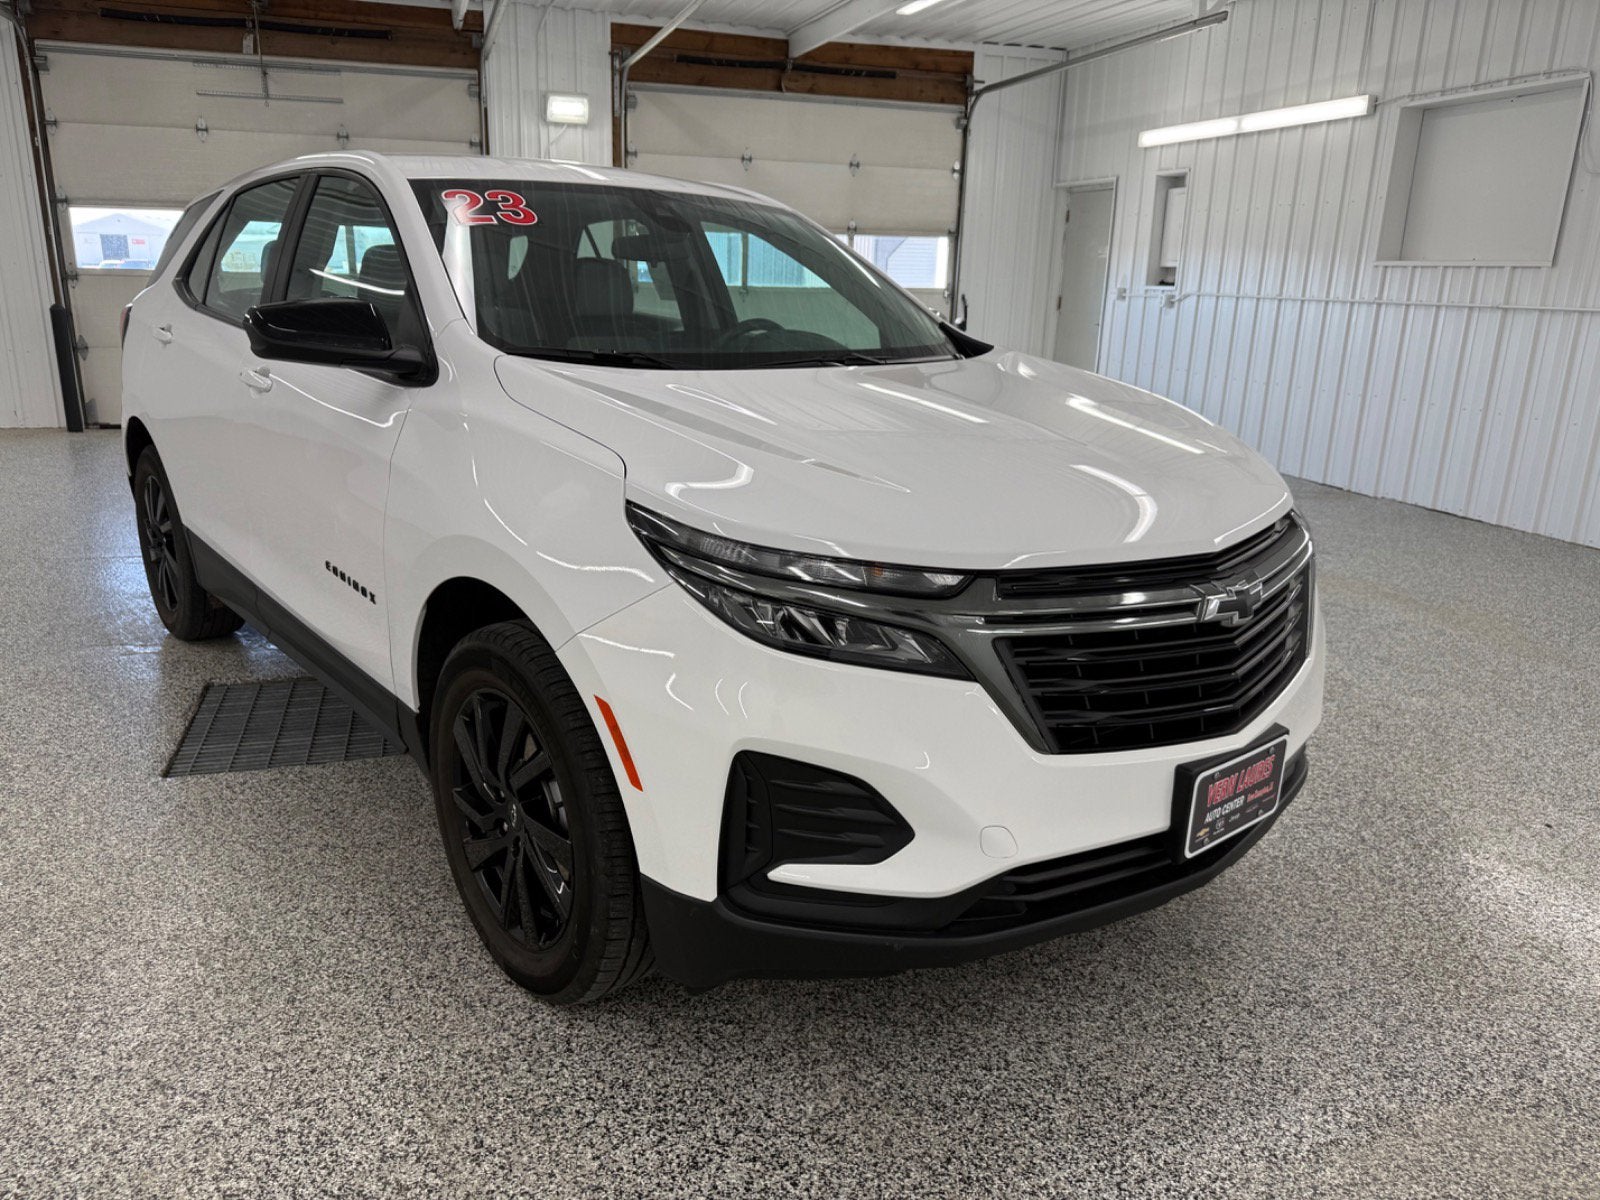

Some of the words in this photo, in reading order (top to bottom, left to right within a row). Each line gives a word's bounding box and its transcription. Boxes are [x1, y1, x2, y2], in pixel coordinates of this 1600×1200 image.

[441, 188, 538, 225] 23
[325, 560, 377, 606] EQUINOX
[1207, 772, 1239, 808] VERN
[1204, 806, 1222, 824] AUTO
[1221, 795, 1245, 816] CENTER
